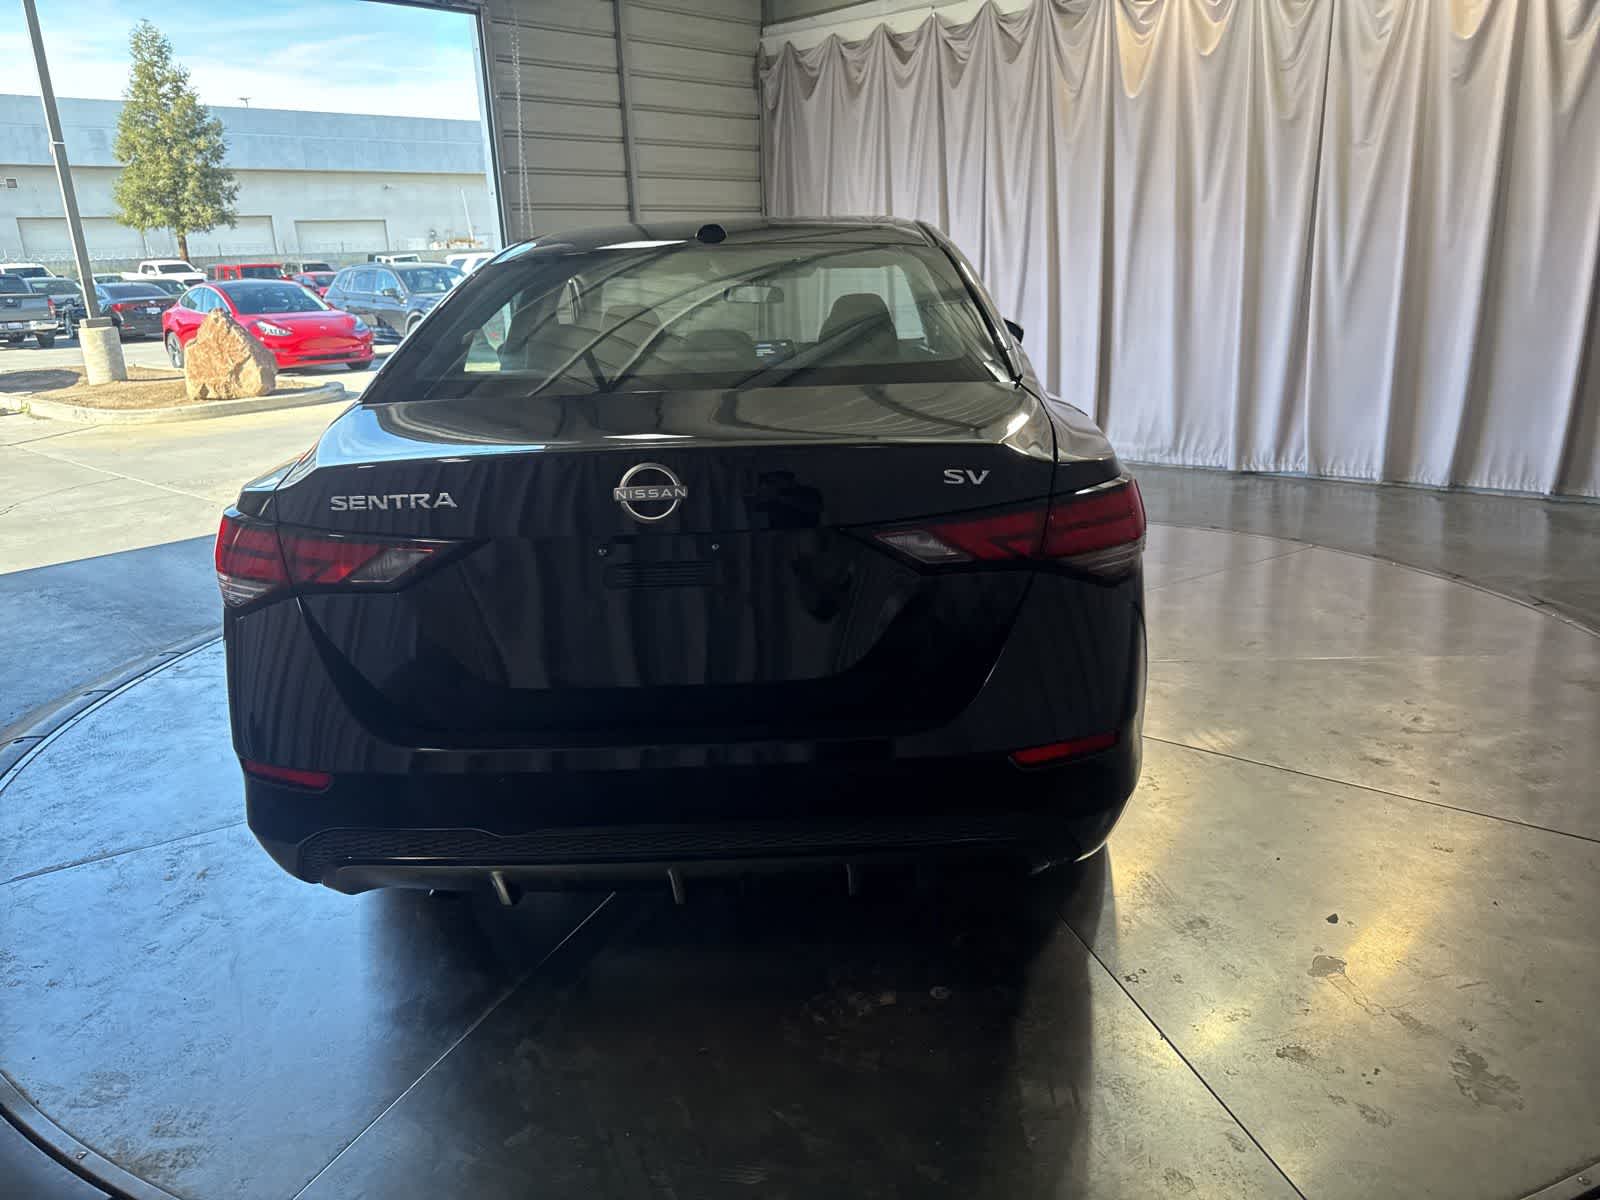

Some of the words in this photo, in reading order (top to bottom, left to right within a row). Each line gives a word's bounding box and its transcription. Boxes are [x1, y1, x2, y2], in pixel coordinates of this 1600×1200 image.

[943, 468, 991, 485] SV
[329, 492, 458, 511] SENTRA
[615, 487, 686, 500] NISSAN
